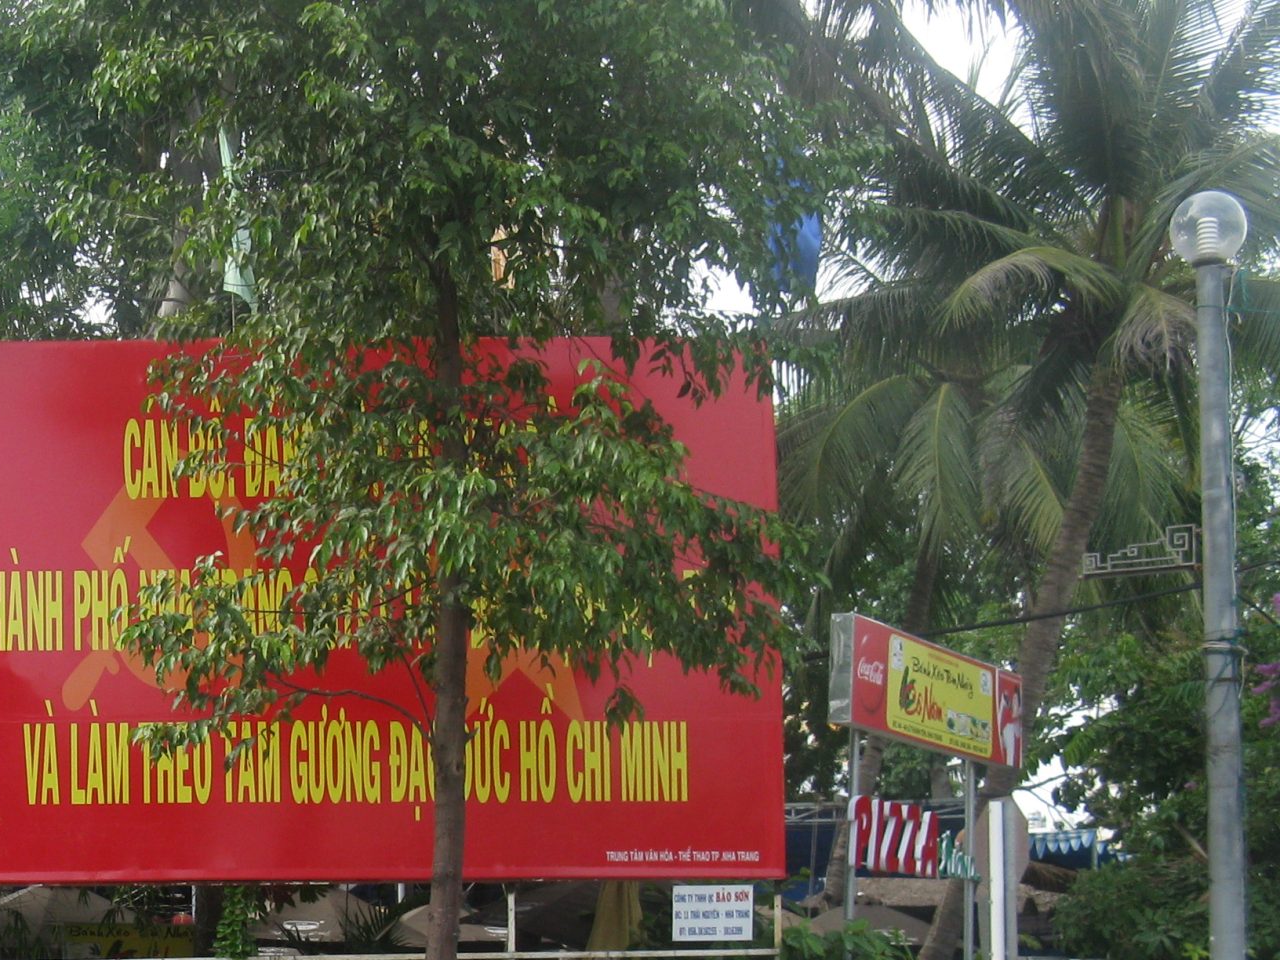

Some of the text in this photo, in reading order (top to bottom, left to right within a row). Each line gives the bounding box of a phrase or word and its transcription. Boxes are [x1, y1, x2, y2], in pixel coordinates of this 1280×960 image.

[73, 536, 131, 651] PHỐ
[23, 699, 60, 805] VÀ
[70, 699, 130, 805] LÀM
[137, 721, 212, 804] THEO
[290, 703, 381, 804] GƯƠNG
[520, 683, 557, 803] HỒ
[621, 720, 688, 802] MINH
[737, 850, 760, 862] TRANG
[847, 795, 942, 878] PIZZA
